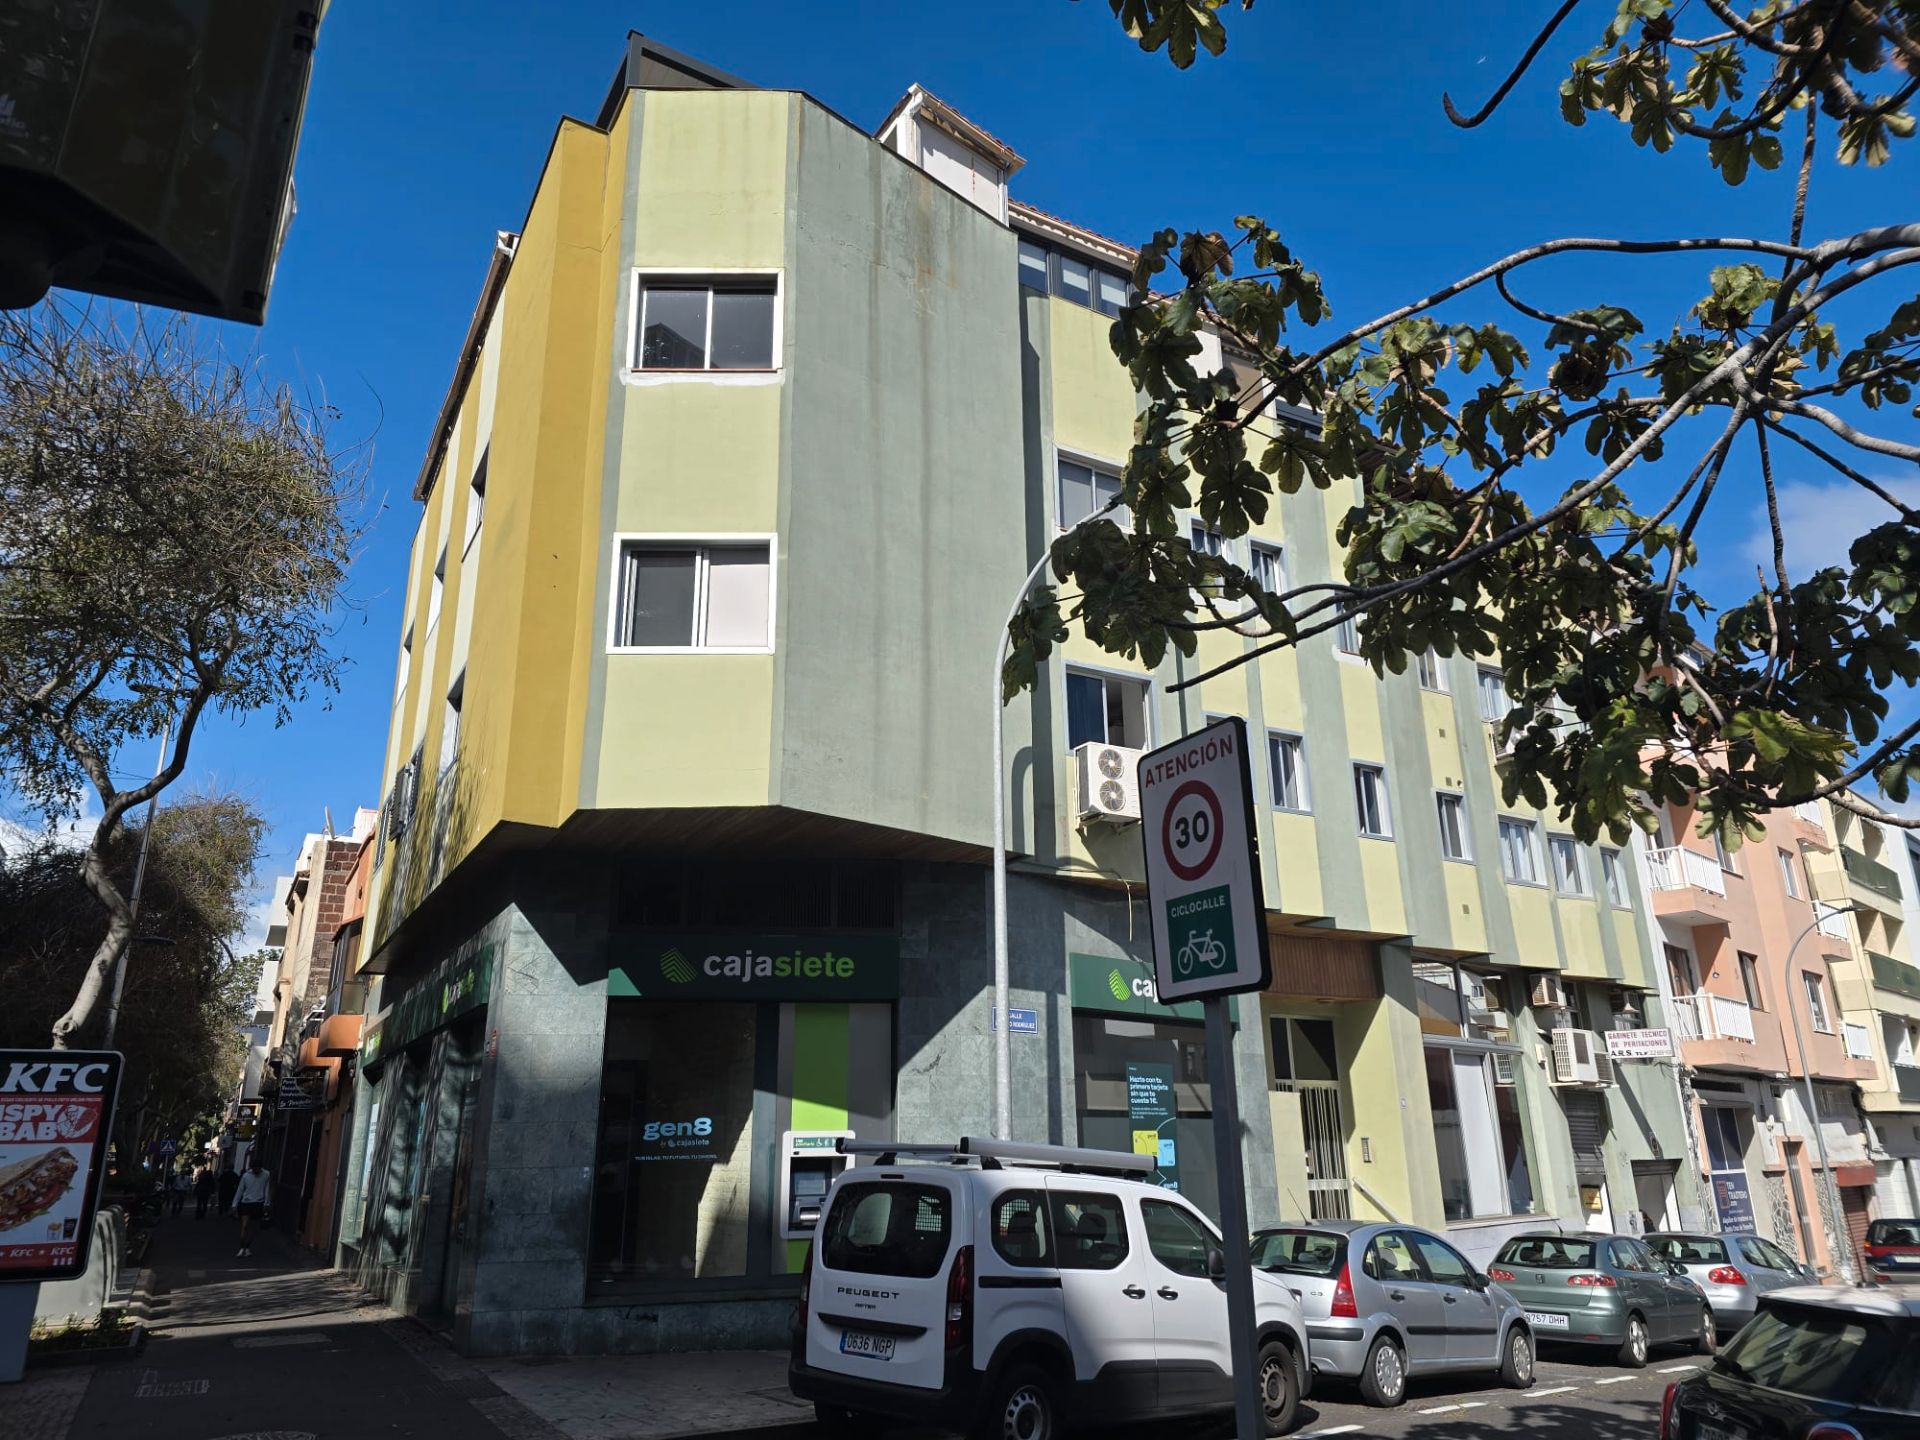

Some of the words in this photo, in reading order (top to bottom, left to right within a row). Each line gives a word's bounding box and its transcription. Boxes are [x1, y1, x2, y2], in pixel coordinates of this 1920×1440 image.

[1145, 735, 1233, 788] ATENCIÓN
[1175, 810, 1209, 849] 30
[1170, 895, 1226, 918] CICLOCALLE
[703, 949, 856, 983] cajasiete
[1607, 1031, 1638, 1040] GABINETE
[1623, 1039, 1668, 1048] PERITACIONES
[0, 1062, 110, 1093] KFC
[642, 1116, 713, 1141] gen8
[9, 1248, 35, 1257] KFC
[50, 1246, 75, 1256] KFC
[837, 1286, 900, 1300] PEUGEOT
[1548, 1315, 1565, 1325] DHH
[847, 1334, 870, 1351] 0636
[871, 1335, 893, 1354] NGP
